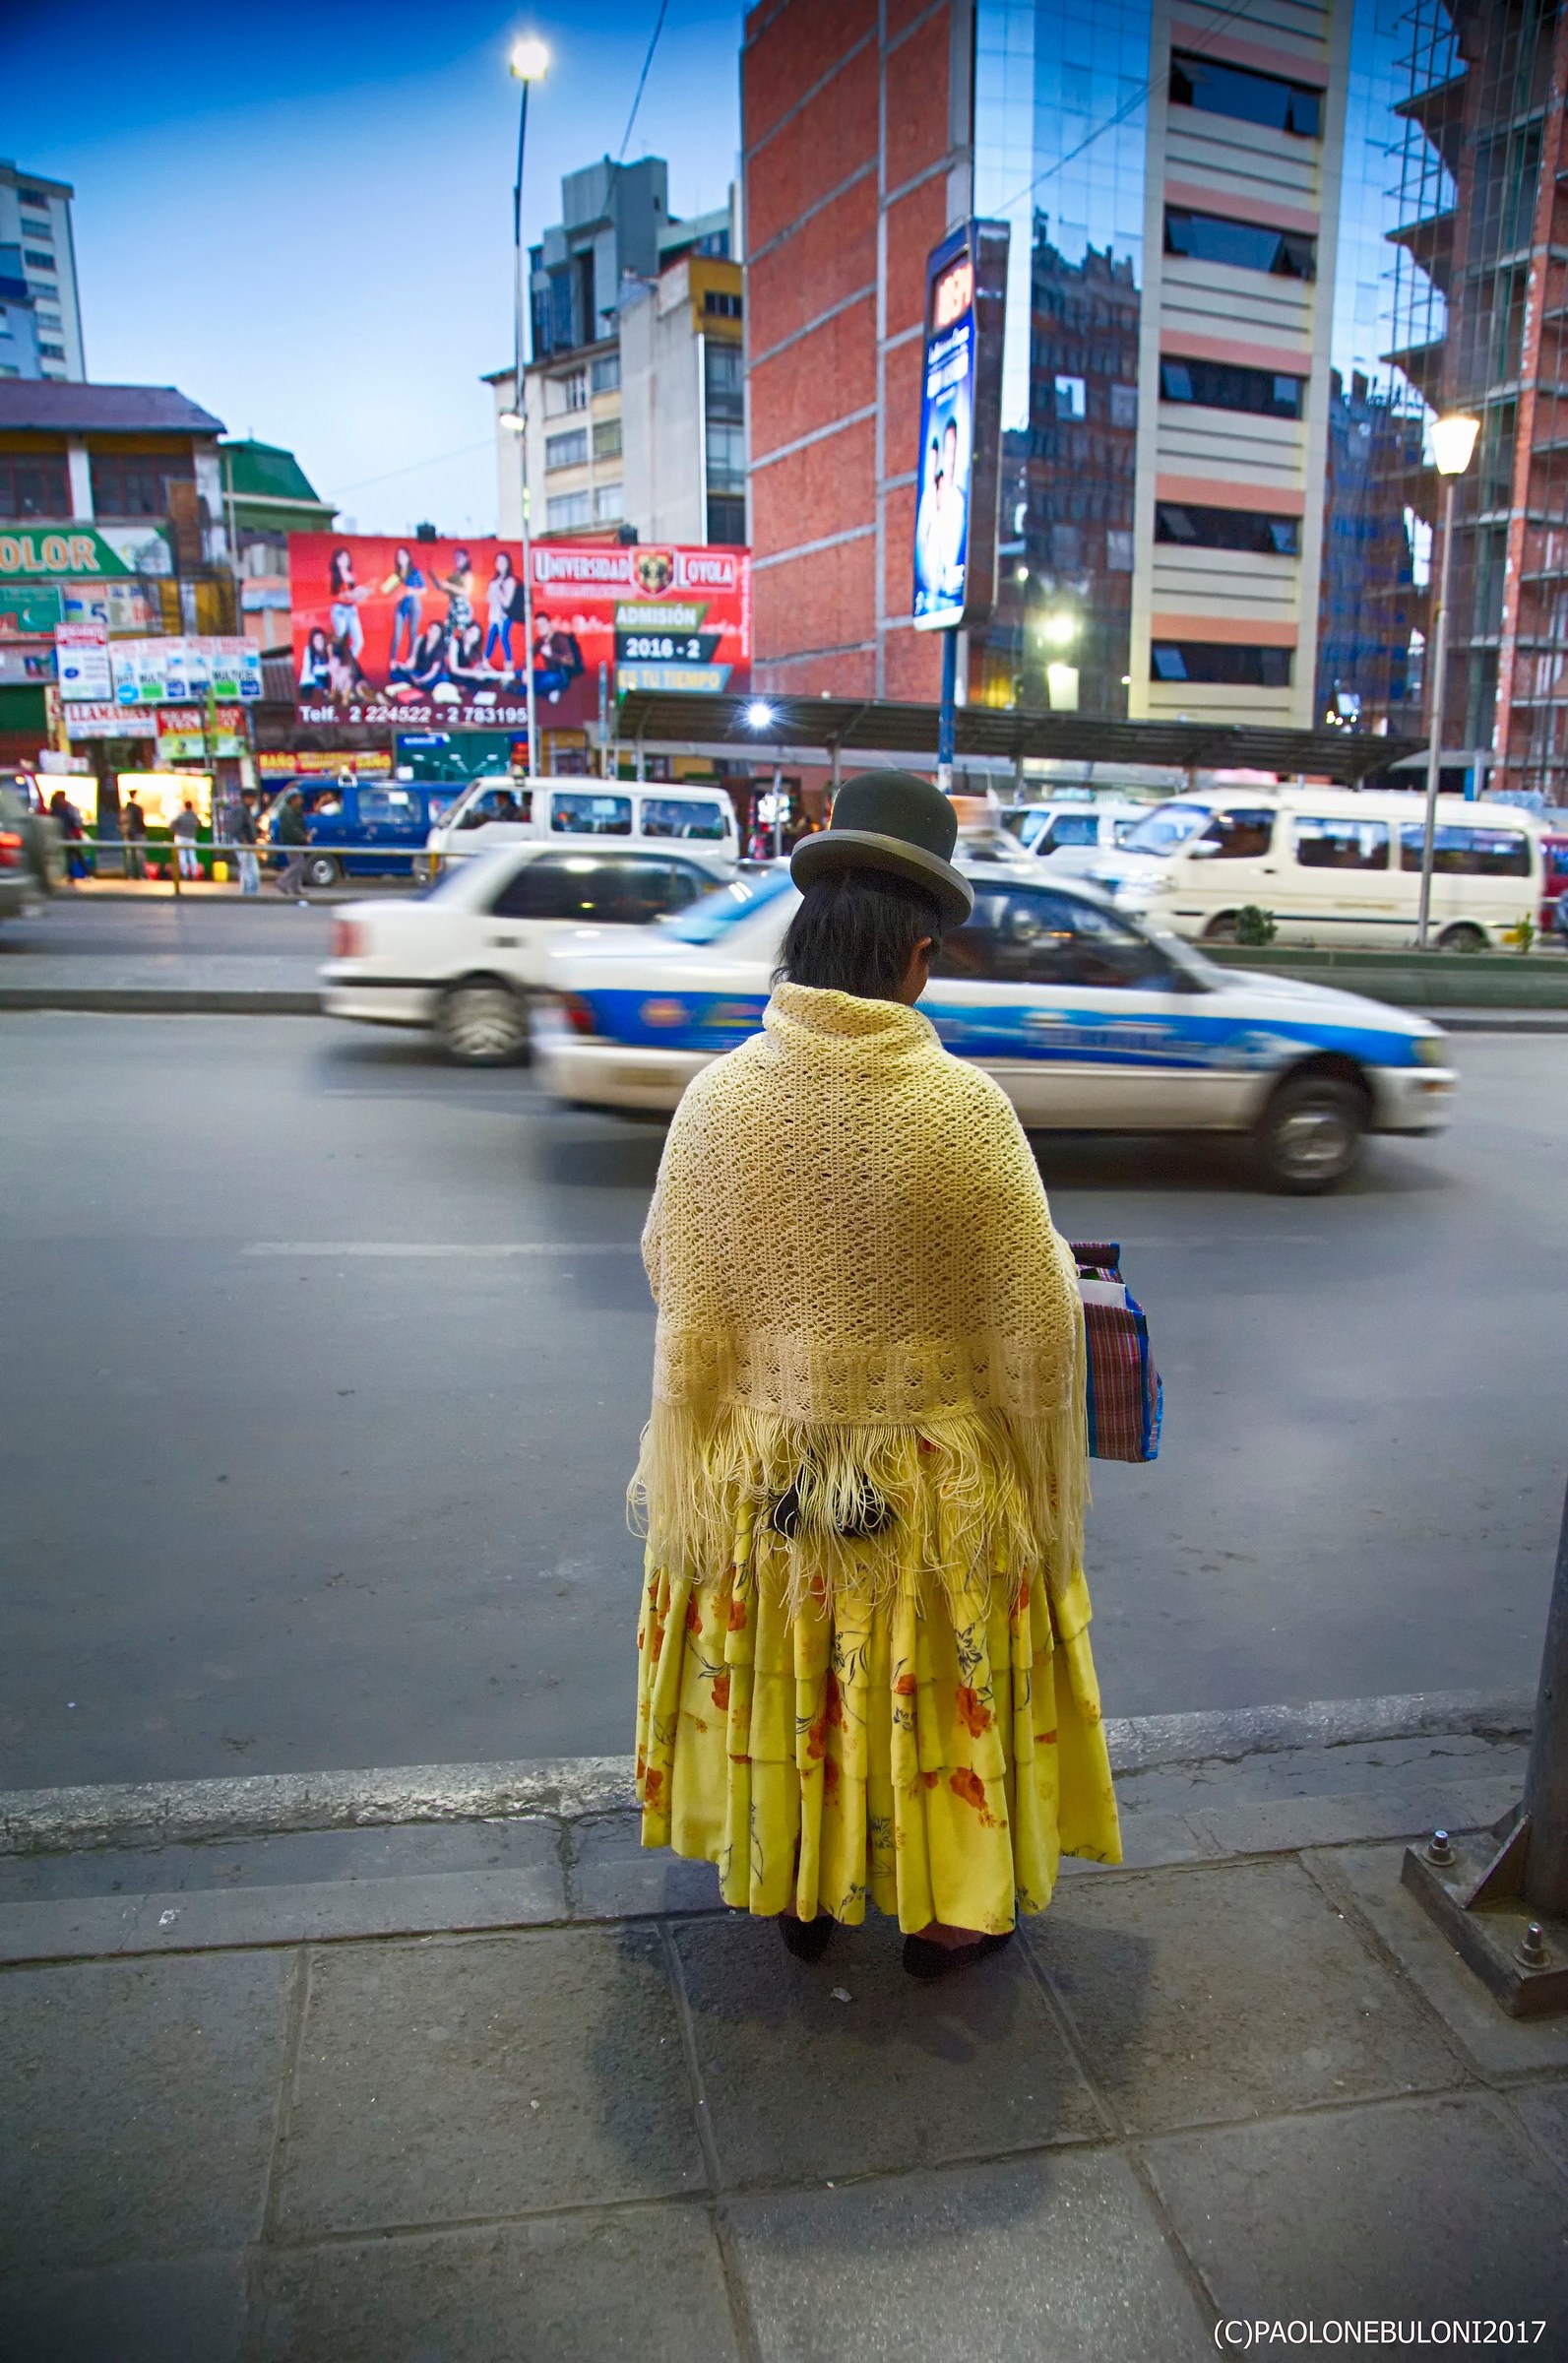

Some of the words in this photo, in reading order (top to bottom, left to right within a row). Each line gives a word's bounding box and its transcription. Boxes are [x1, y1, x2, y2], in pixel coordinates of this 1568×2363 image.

[534, 551, 630, 581] UNIVERSIDAD
[679, 555, 733, 588] LOYOLA
[616, 604, 697, 625] ADMISIÓN
[626, 637, 674, 659] 2016
[687, 639, 700, 659] 2
[642, 671, 659, 687] TU
[664, 671, 721, 688] TIEMPO
[299, 705, 340, 723] Telf.
[349, 706, 361, 723] 2
[365, 706, 432, 723] 224522
[448, 706, 460, 723] 2
[464, 706, 529, 723] 783195
